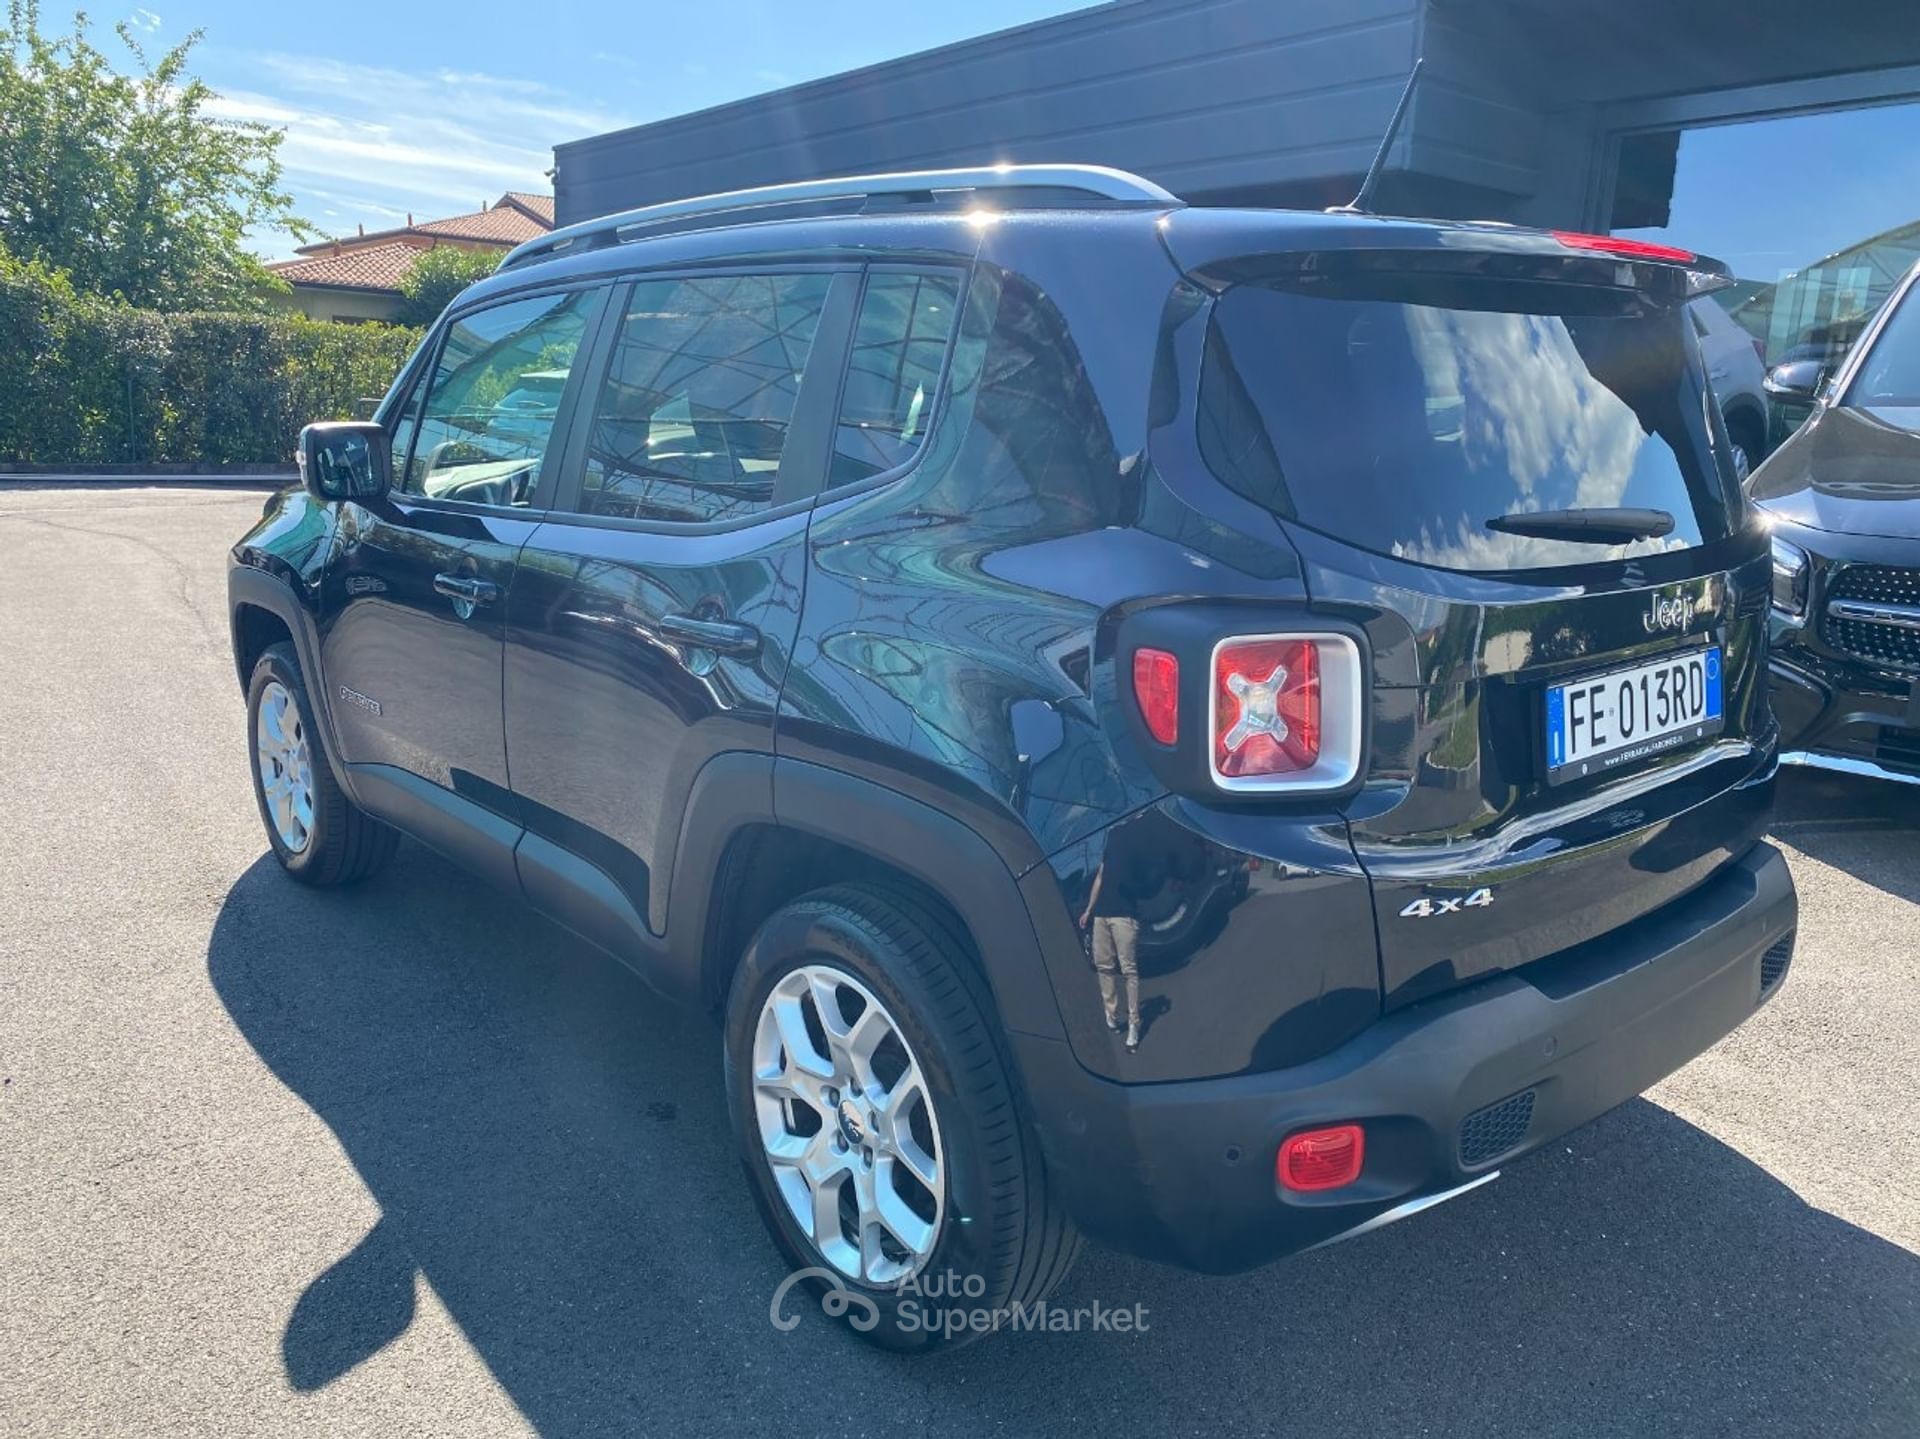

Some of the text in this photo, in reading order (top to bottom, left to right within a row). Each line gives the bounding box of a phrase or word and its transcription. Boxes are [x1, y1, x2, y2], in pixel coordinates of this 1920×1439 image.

[1643, 593, 1693, 633] Jeep
[1569, 660, 1704, 754] FE 013RD
[1399, 887, 1494, 918] 4x4
